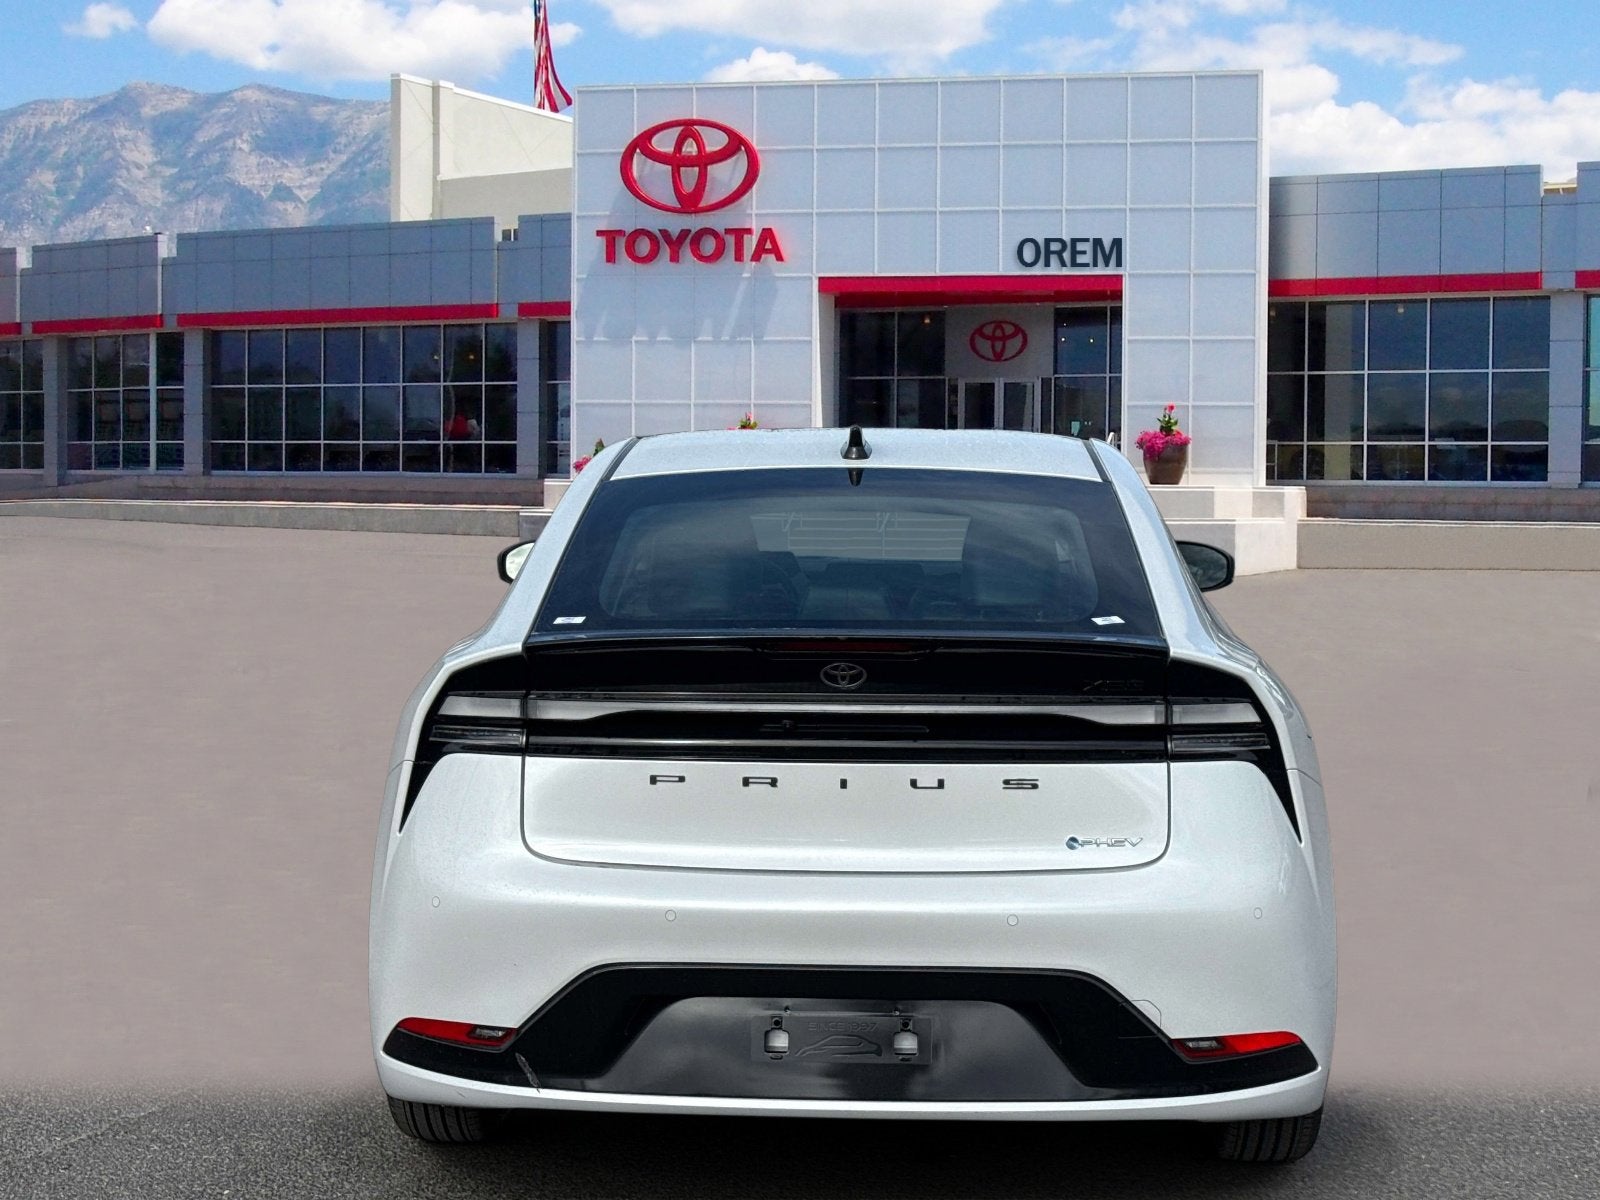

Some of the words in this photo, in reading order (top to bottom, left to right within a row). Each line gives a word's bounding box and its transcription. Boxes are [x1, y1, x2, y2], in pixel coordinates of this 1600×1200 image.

[596, 227, 784, 264] TOYOTA
[1017, 237, 1122, 268] OREM
[649, 774, 1040, 790] PRIUS
[1079, 837, 1143, 848] PHEV
